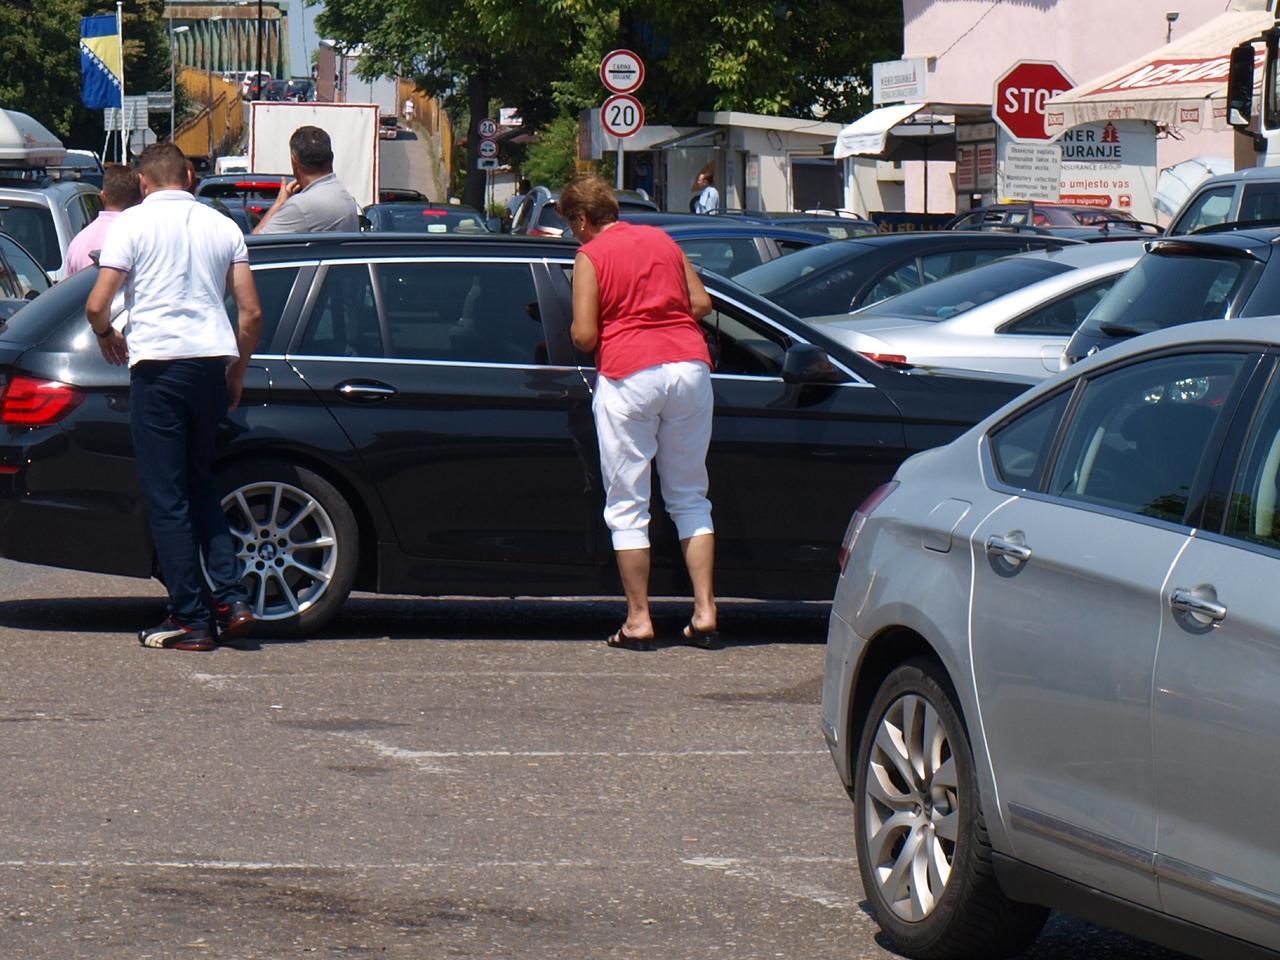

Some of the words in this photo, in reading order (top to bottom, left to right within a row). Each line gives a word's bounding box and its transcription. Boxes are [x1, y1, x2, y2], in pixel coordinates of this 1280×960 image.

[611, 105, 634, 126] 20
[483, 123, 494, 133] 20
[1070, 179, 1109, 190] umjesto
[1112, 180, 1130, 188] vas
